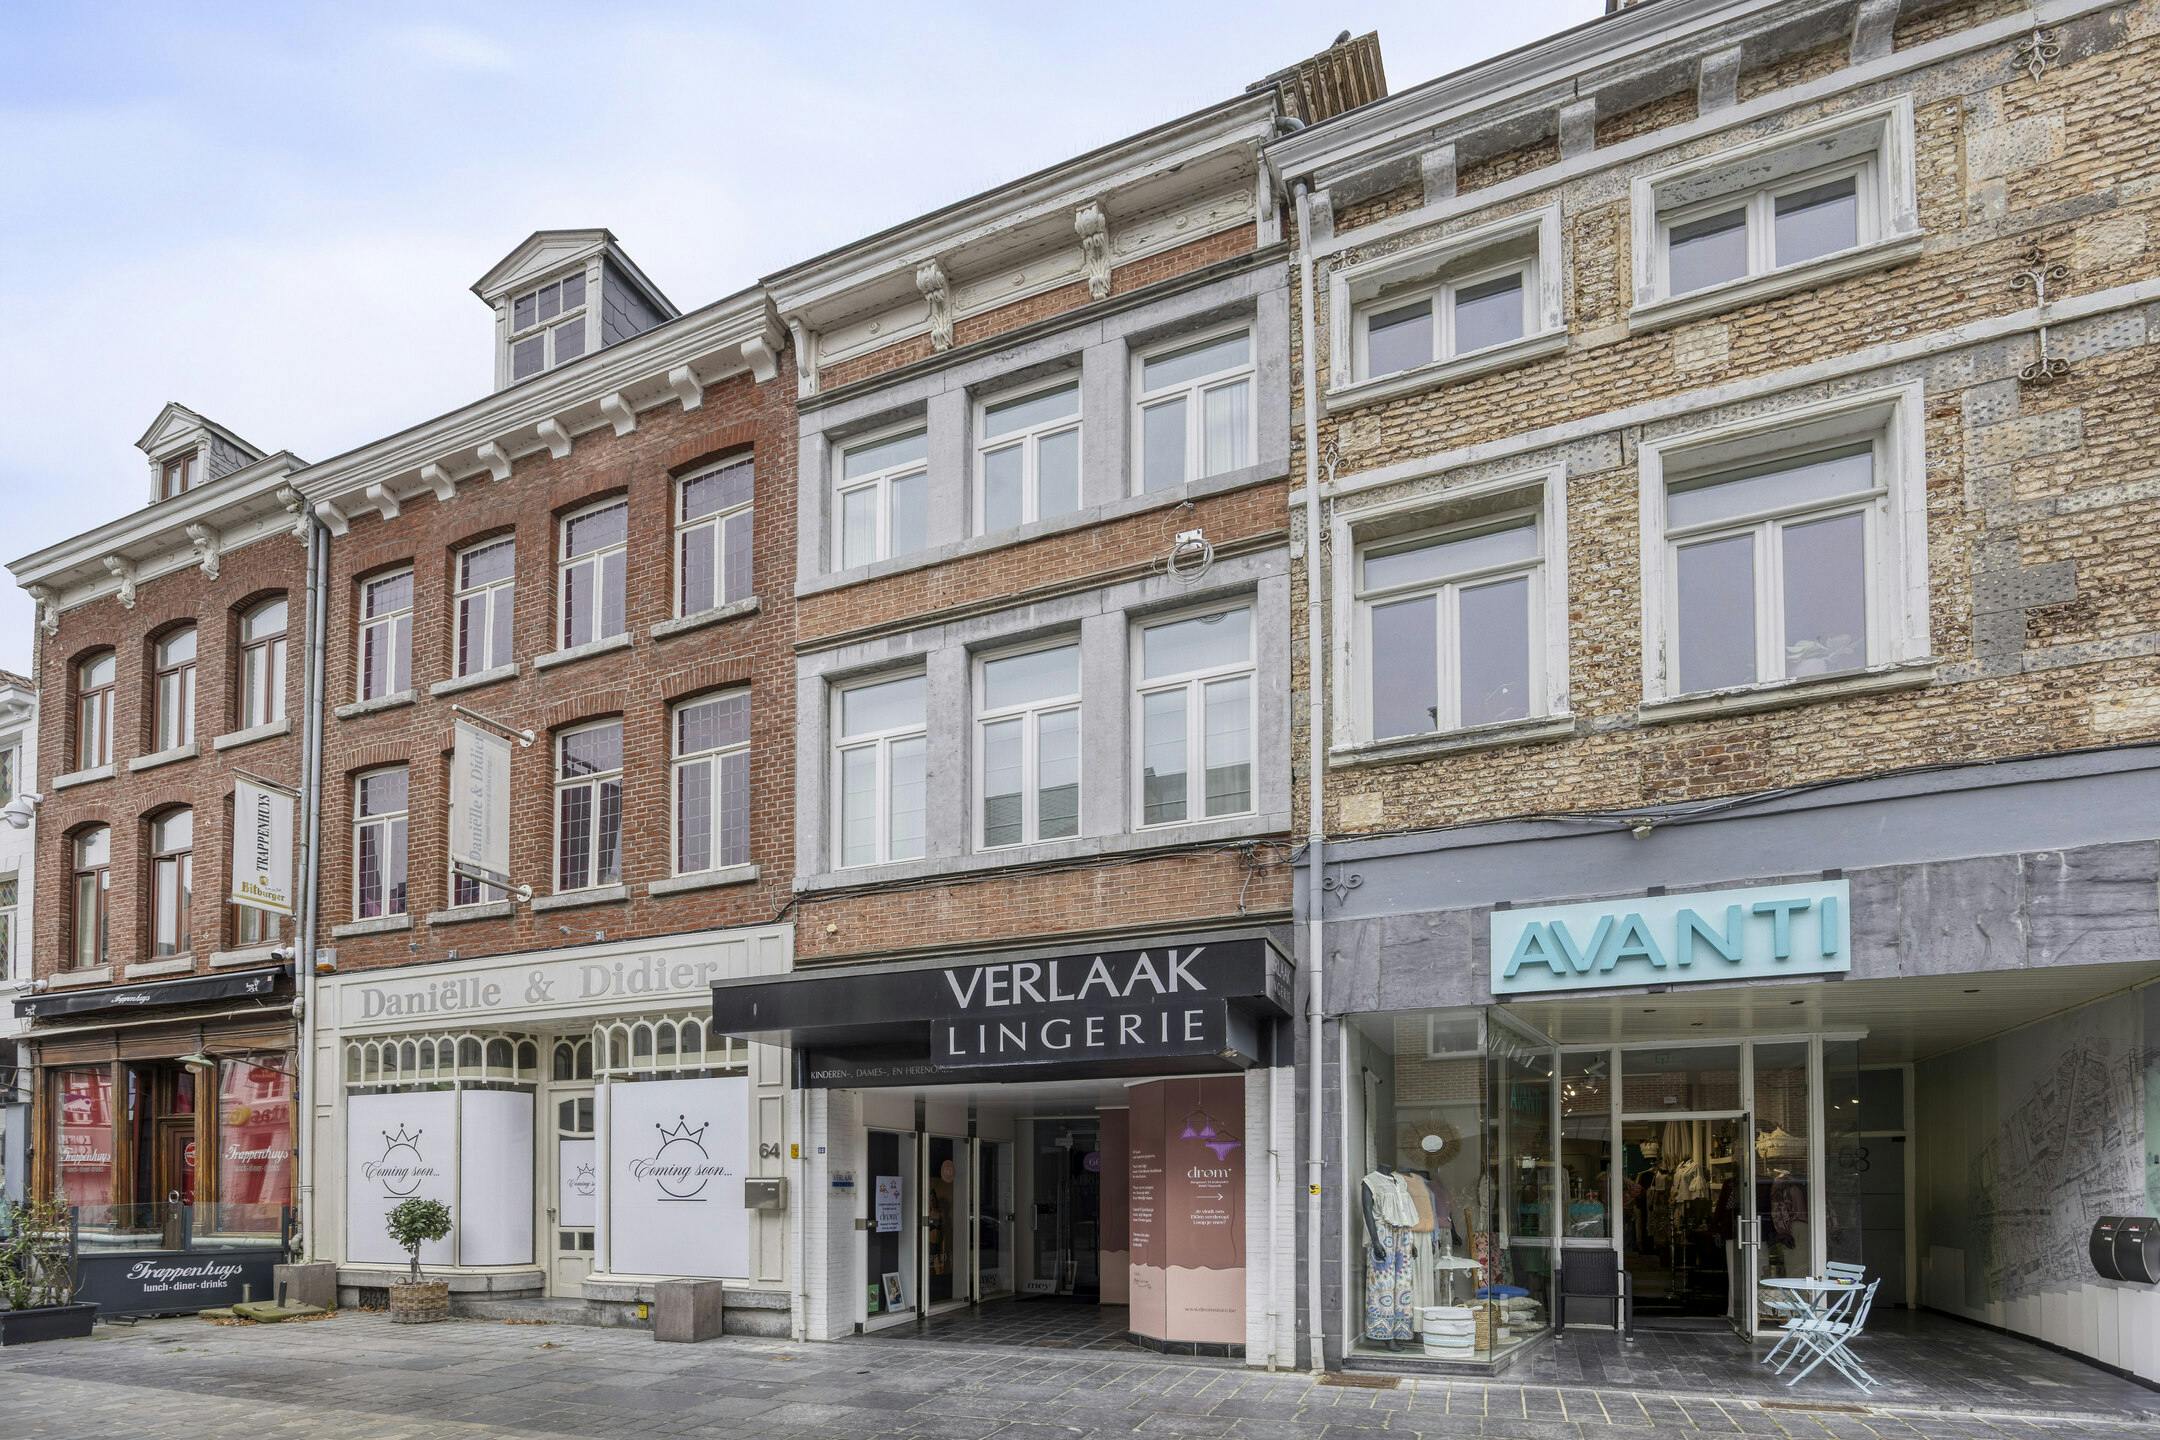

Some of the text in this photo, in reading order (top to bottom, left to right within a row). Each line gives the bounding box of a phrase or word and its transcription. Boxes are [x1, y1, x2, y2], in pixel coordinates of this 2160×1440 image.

[468, 733, 485, 862] Daniëlle & Didier
[256, 794, 270, 872] TRAPPENHUYS
[242, 881, 285, 902] Bitburger
[1503, 897, 1837, 978] AVANTI
[361, 956, 718, 1019] Daniëlle & Didier
[944, 947, 1207, 1008] VERLAAK
[949, 1009, 1204, 1055] LINGERIE
[892, 1067, 903, 1076] EN
[61, 1147, 111, 1166] Trappenhuys
[224, 1143, 289, 1167] Trappenhuys
[759, 1143, 780, 1159] 64
[361, 1160, 440, 1183] Coming soon...
[628, 1158, 733, 1184] Coming soon...
[126, 1260, 243, 1282] Trappenhuys
